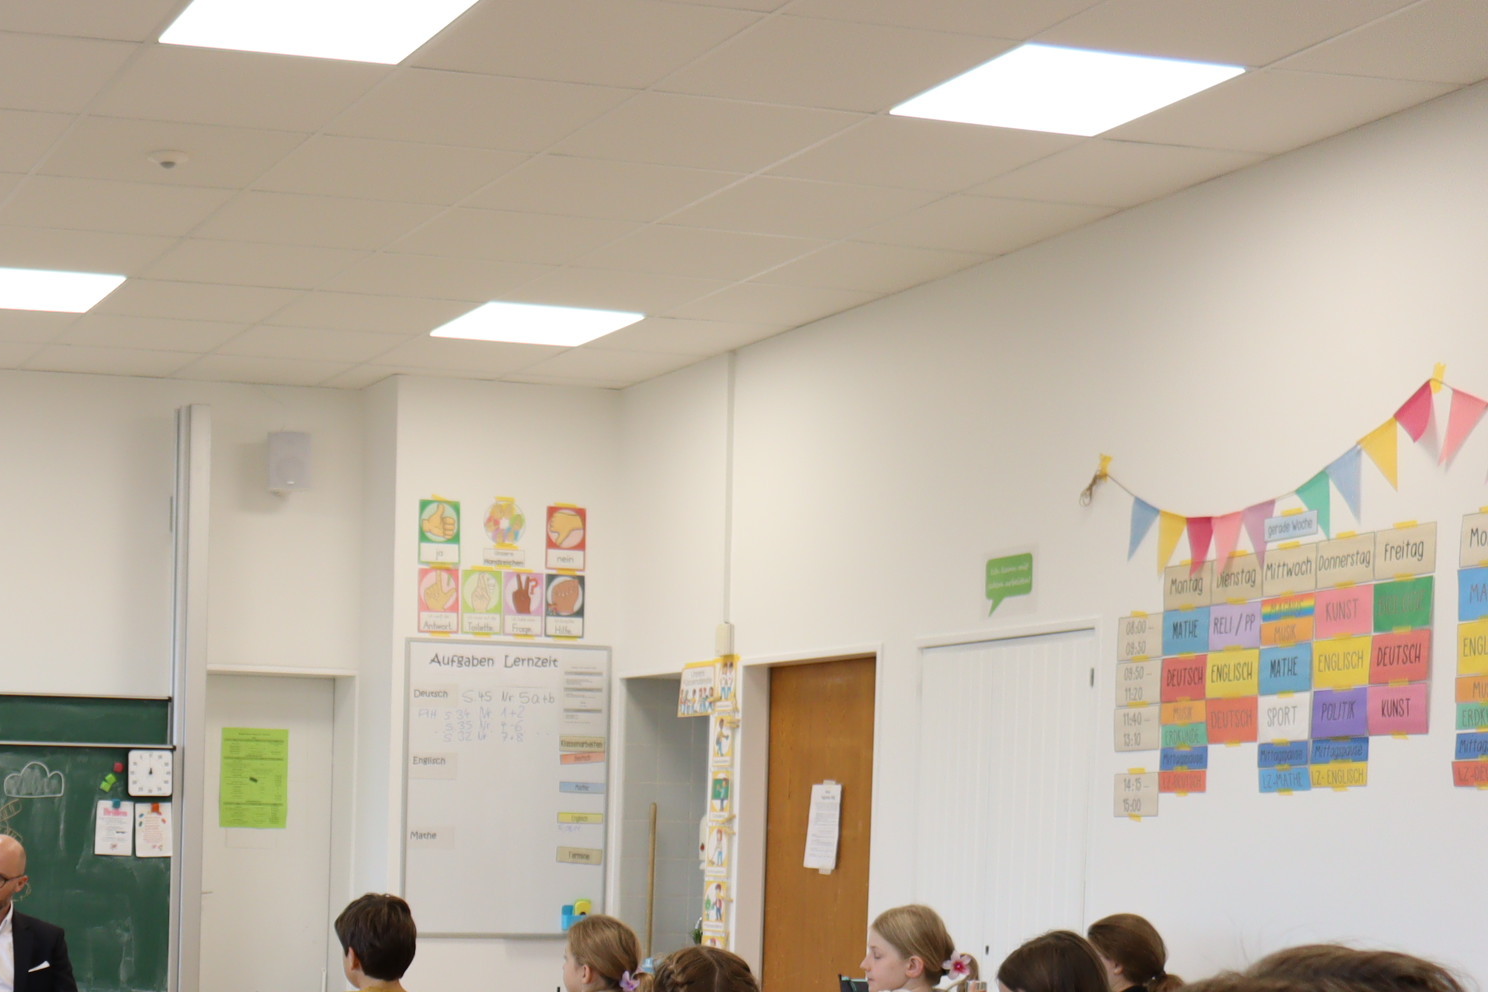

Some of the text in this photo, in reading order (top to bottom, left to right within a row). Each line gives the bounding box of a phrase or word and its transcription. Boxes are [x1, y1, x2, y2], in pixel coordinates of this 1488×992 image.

[1292, 519, 1313, 531] Woche
[556, 555, 575, 564] nein
[1318, 549, 1372, 572] Donnerstag
[1384, 540, 1424, 562] Freitag
[1264, 555, 1313, 582] Mittwoch
[1169, 576, 1204, 596] Montag
[1325, 598, 1359, 622] KUNST
[1172, 619, 1199, 640] MATHE
[1213, 616, 1233, 636] RELI
[1244, 613, 1256, 632] PP
[429, 652, 495, 669] Aufgaben
[1317, 649, 1365, 673] ENGLISCH
[1376, 643, 1422, 667] DEUTSCH
[1166, 666, 1204, 688] DEUTSCH
[1210, 661, 1253, 684] ENGLISCH
[1269, 656, 1299, 679] MATHE
[413, 688, 449, 699] Deutsch
[1211, 709, 1253, 729] DEUTSCH
[1266, 705, 1298, 727] SPORT
[1320, 700, 1357, 722] POLITIK
[1381, 697, 1411, 719] KUNST
[412, 755, 447, 766] Englisch
[409, 830, 438, 841] Mathe
